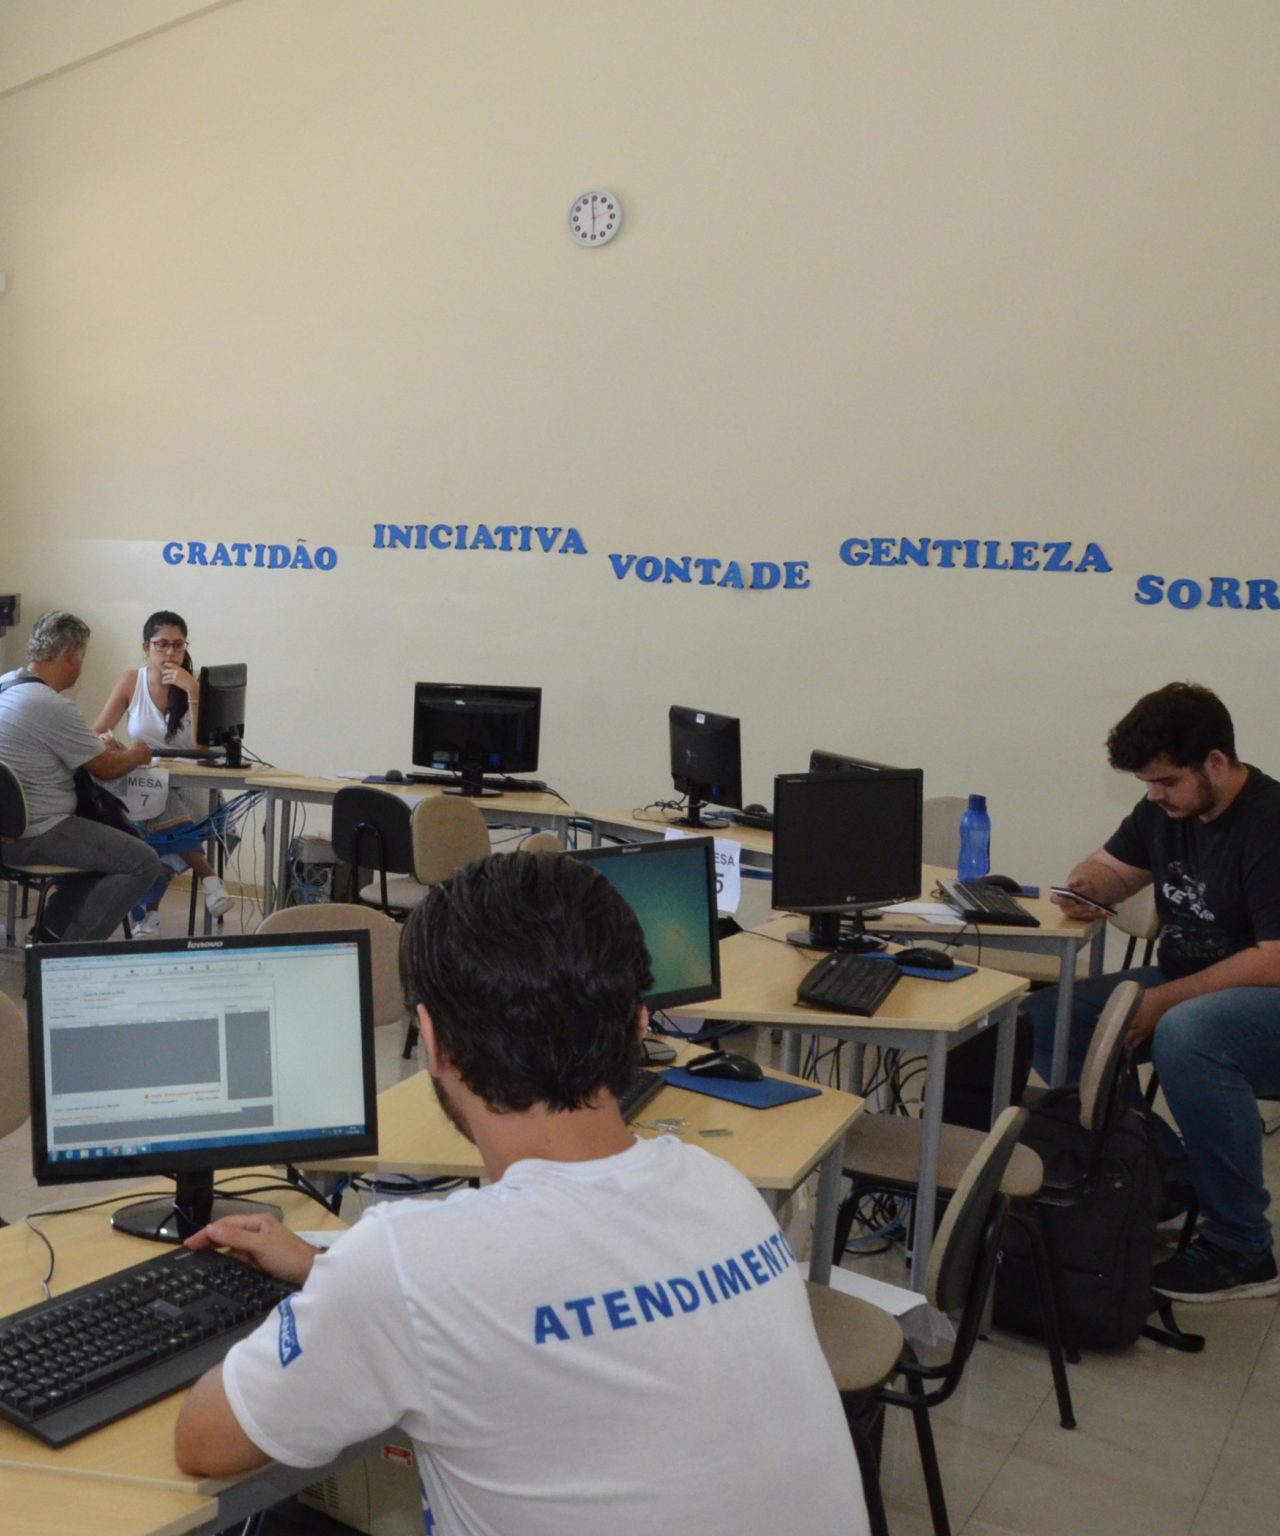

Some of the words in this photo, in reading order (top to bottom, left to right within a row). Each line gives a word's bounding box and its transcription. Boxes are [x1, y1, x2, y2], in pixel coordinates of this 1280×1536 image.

[163, 538, 338, 571] GRATIDÃO
[373, 523, 588, 555] INICIATIVA
[839, 537, 1113, 573] GENTILEZA
[609, 553, 811, 590] VONTADE
[128, 776, 163, 789] MESA
[140, 793, 150, 807] 7
[714, 853, 735, 867] ESA
